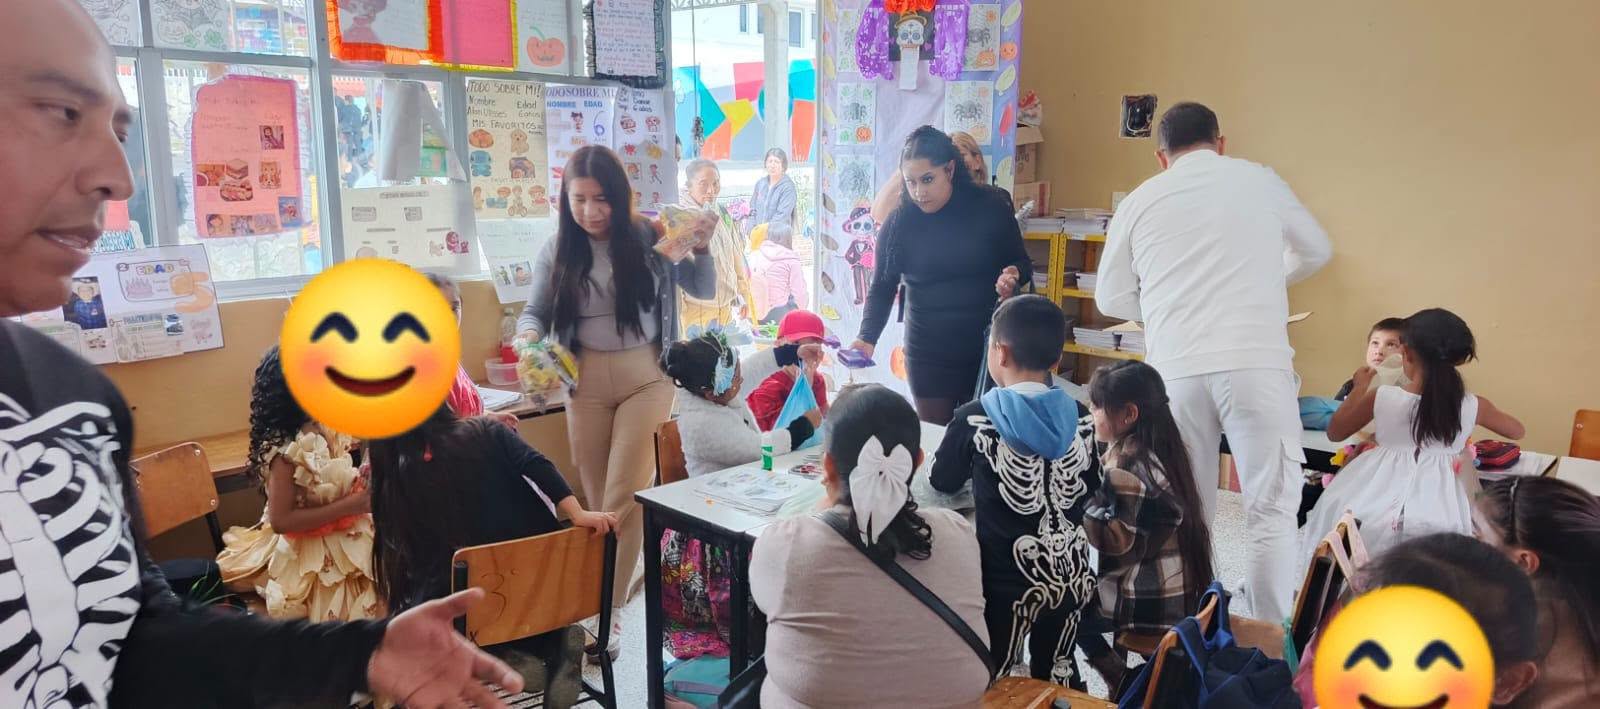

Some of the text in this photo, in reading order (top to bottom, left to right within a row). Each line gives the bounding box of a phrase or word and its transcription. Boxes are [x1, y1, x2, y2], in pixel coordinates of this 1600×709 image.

[495, 82, 521, 95] SOBRE
[546, 87, 567, 97] ODO
[567, 87, 600, 97] SOBRE
[469, 95, 496, 106] Nombre
[516, 99, 537, 110] Edad
[583, 100, 603, 108] EDAD
[472, 119, 486, 129] MIS
[490, 120, 537, 130] FAVORITOS
[593, 110, 606, 137] 6
[135, 264, 175, 276] EDAD
